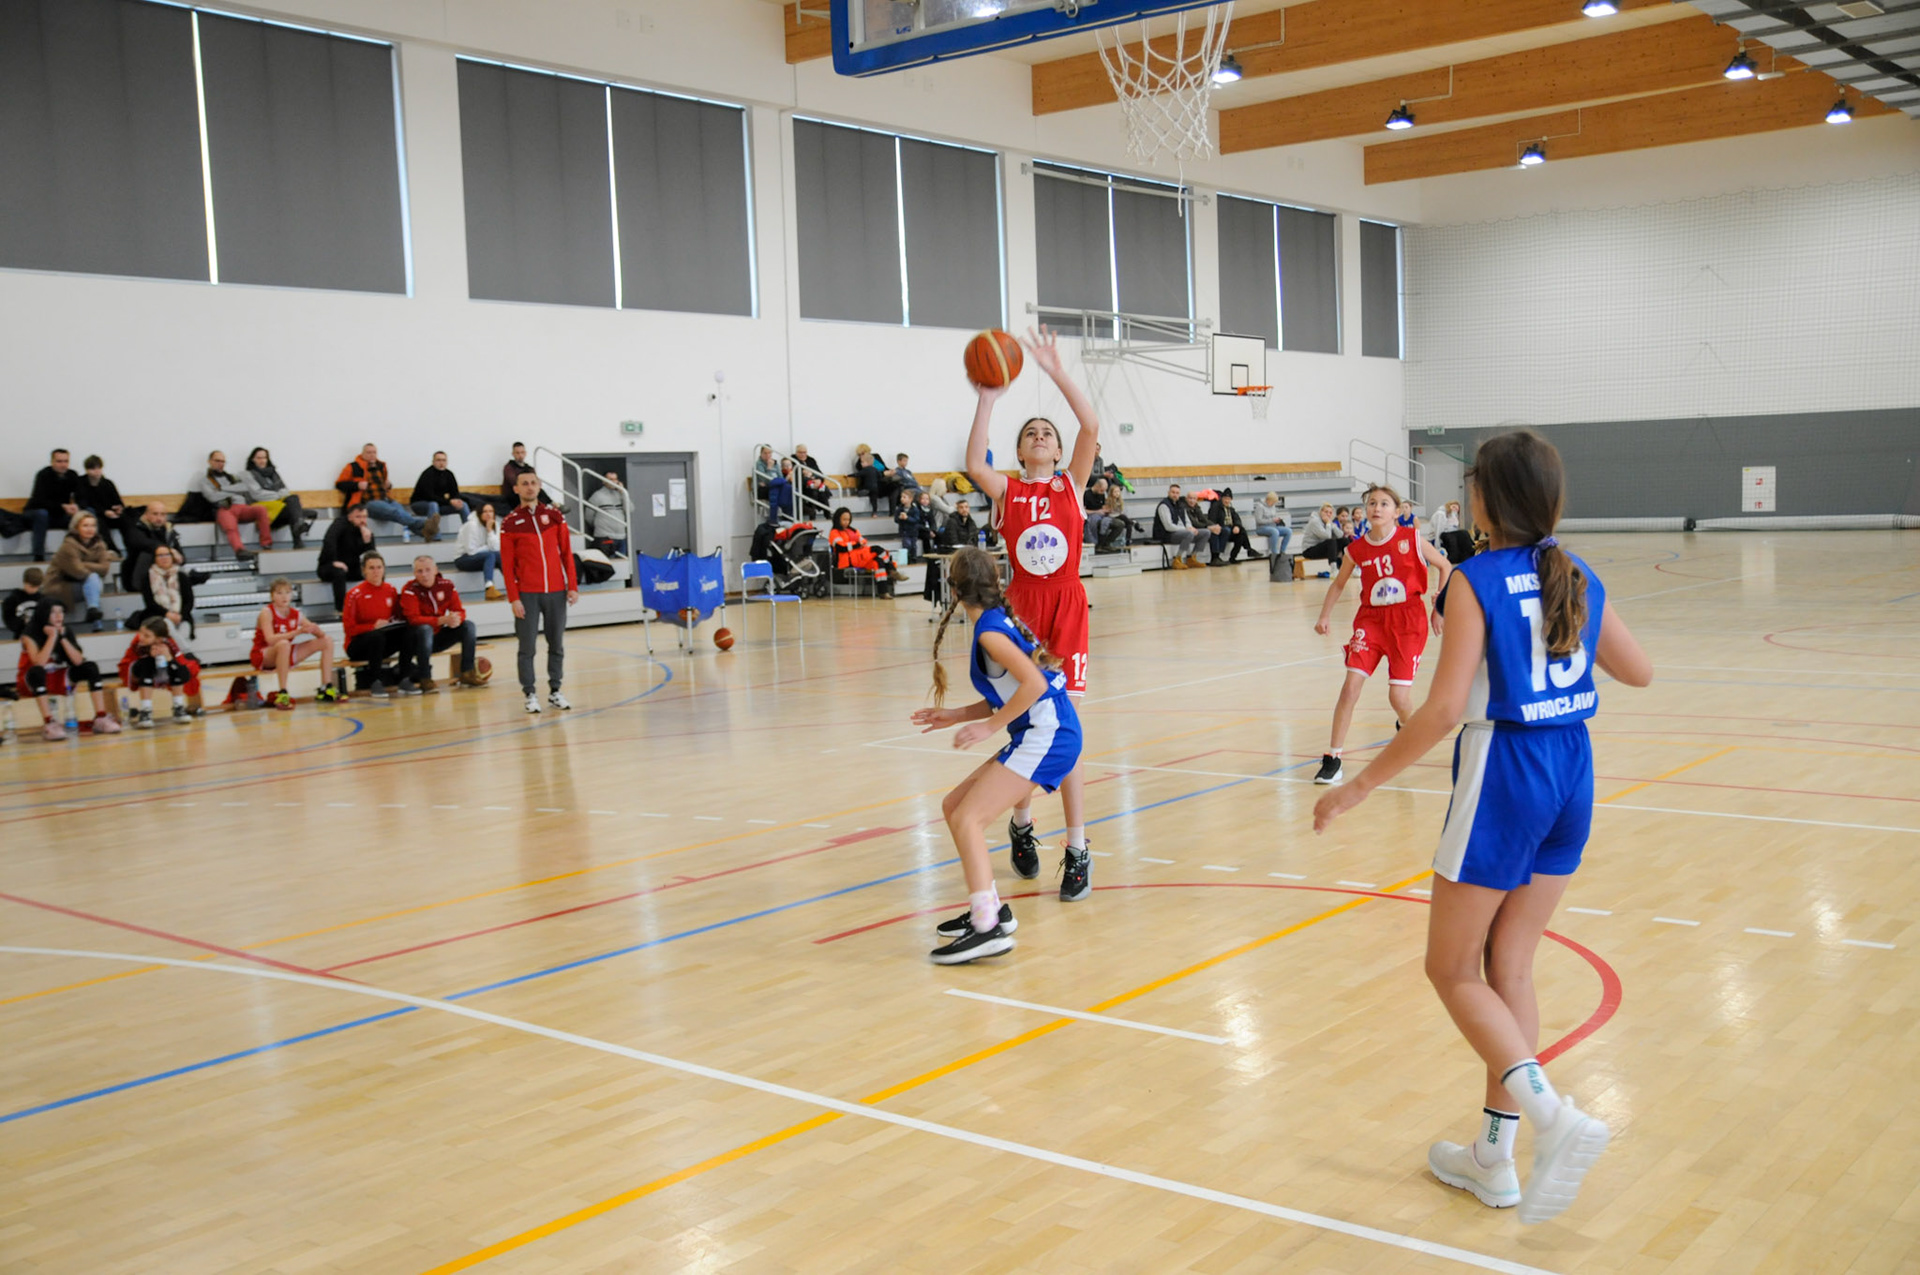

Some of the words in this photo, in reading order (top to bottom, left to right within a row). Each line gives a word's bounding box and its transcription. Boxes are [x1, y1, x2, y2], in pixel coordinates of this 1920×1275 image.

[1029, 496, 1052, 522] 12
[1373, 554, 1394, 578] 13
[1505, 573, 1542, 595] MKS
[1520, 691, 1596, 722] WROCŁAW
